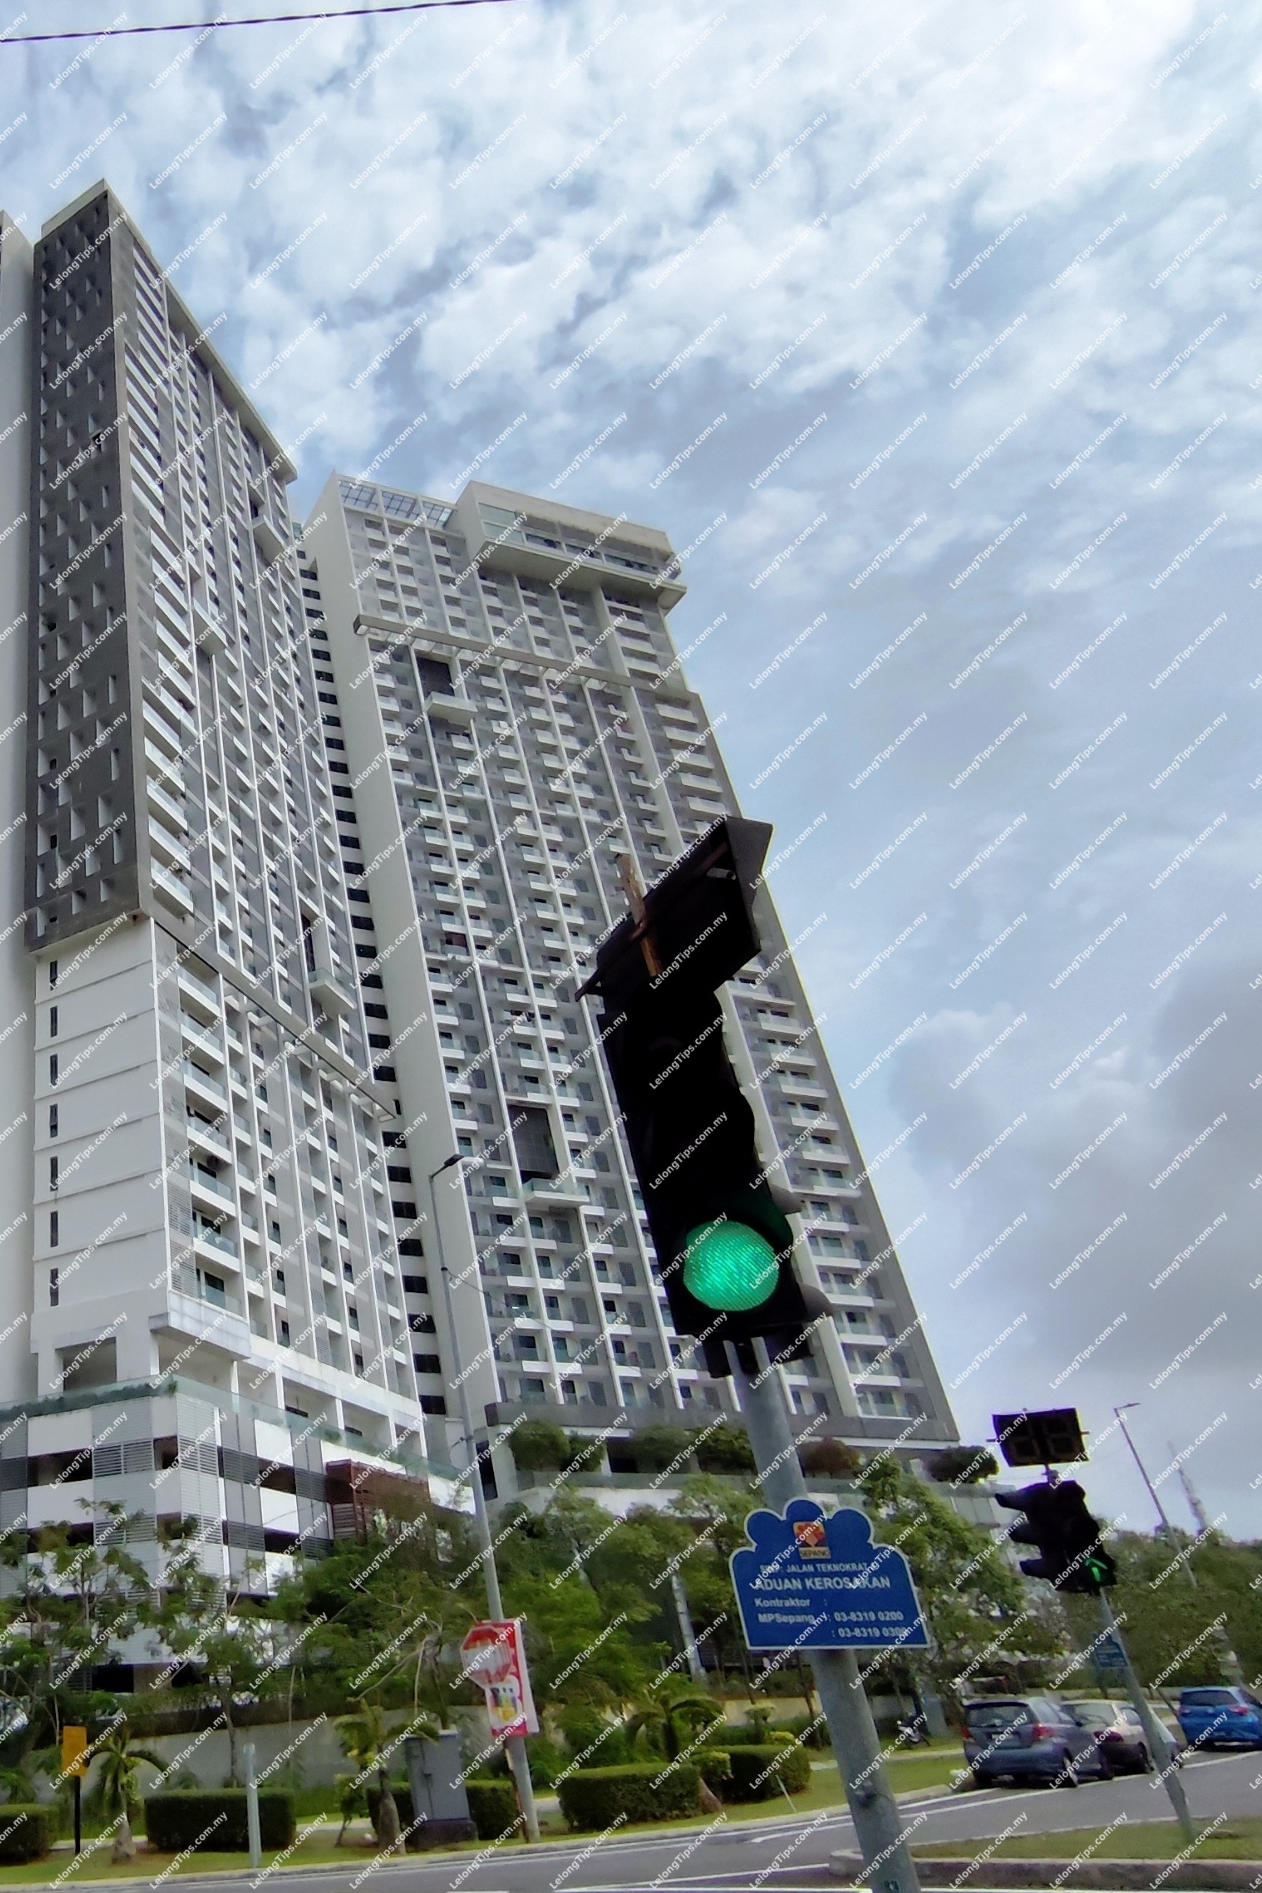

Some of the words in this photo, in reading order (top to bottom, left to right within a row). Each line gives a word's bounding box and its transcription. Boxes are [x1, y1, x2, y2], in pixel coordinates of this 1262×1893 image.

[786, 1564, 815, 1573] JALAN
[816, 1562, 868, 1572] TEKNOKRAT
[755, 1578, 803, 1591] ADUAN
[804, 1576, 891, 1590] KEROSAKAN
[754, 1598, 811, 1607] Kontraktor
[758, 1613, 815, 1624] MPSepang
[834, 1611, 876, 1622] 03-8319
[878, 1611, 904, 1621] 0200
[838, 1627, 880, 1638] 03-8319
